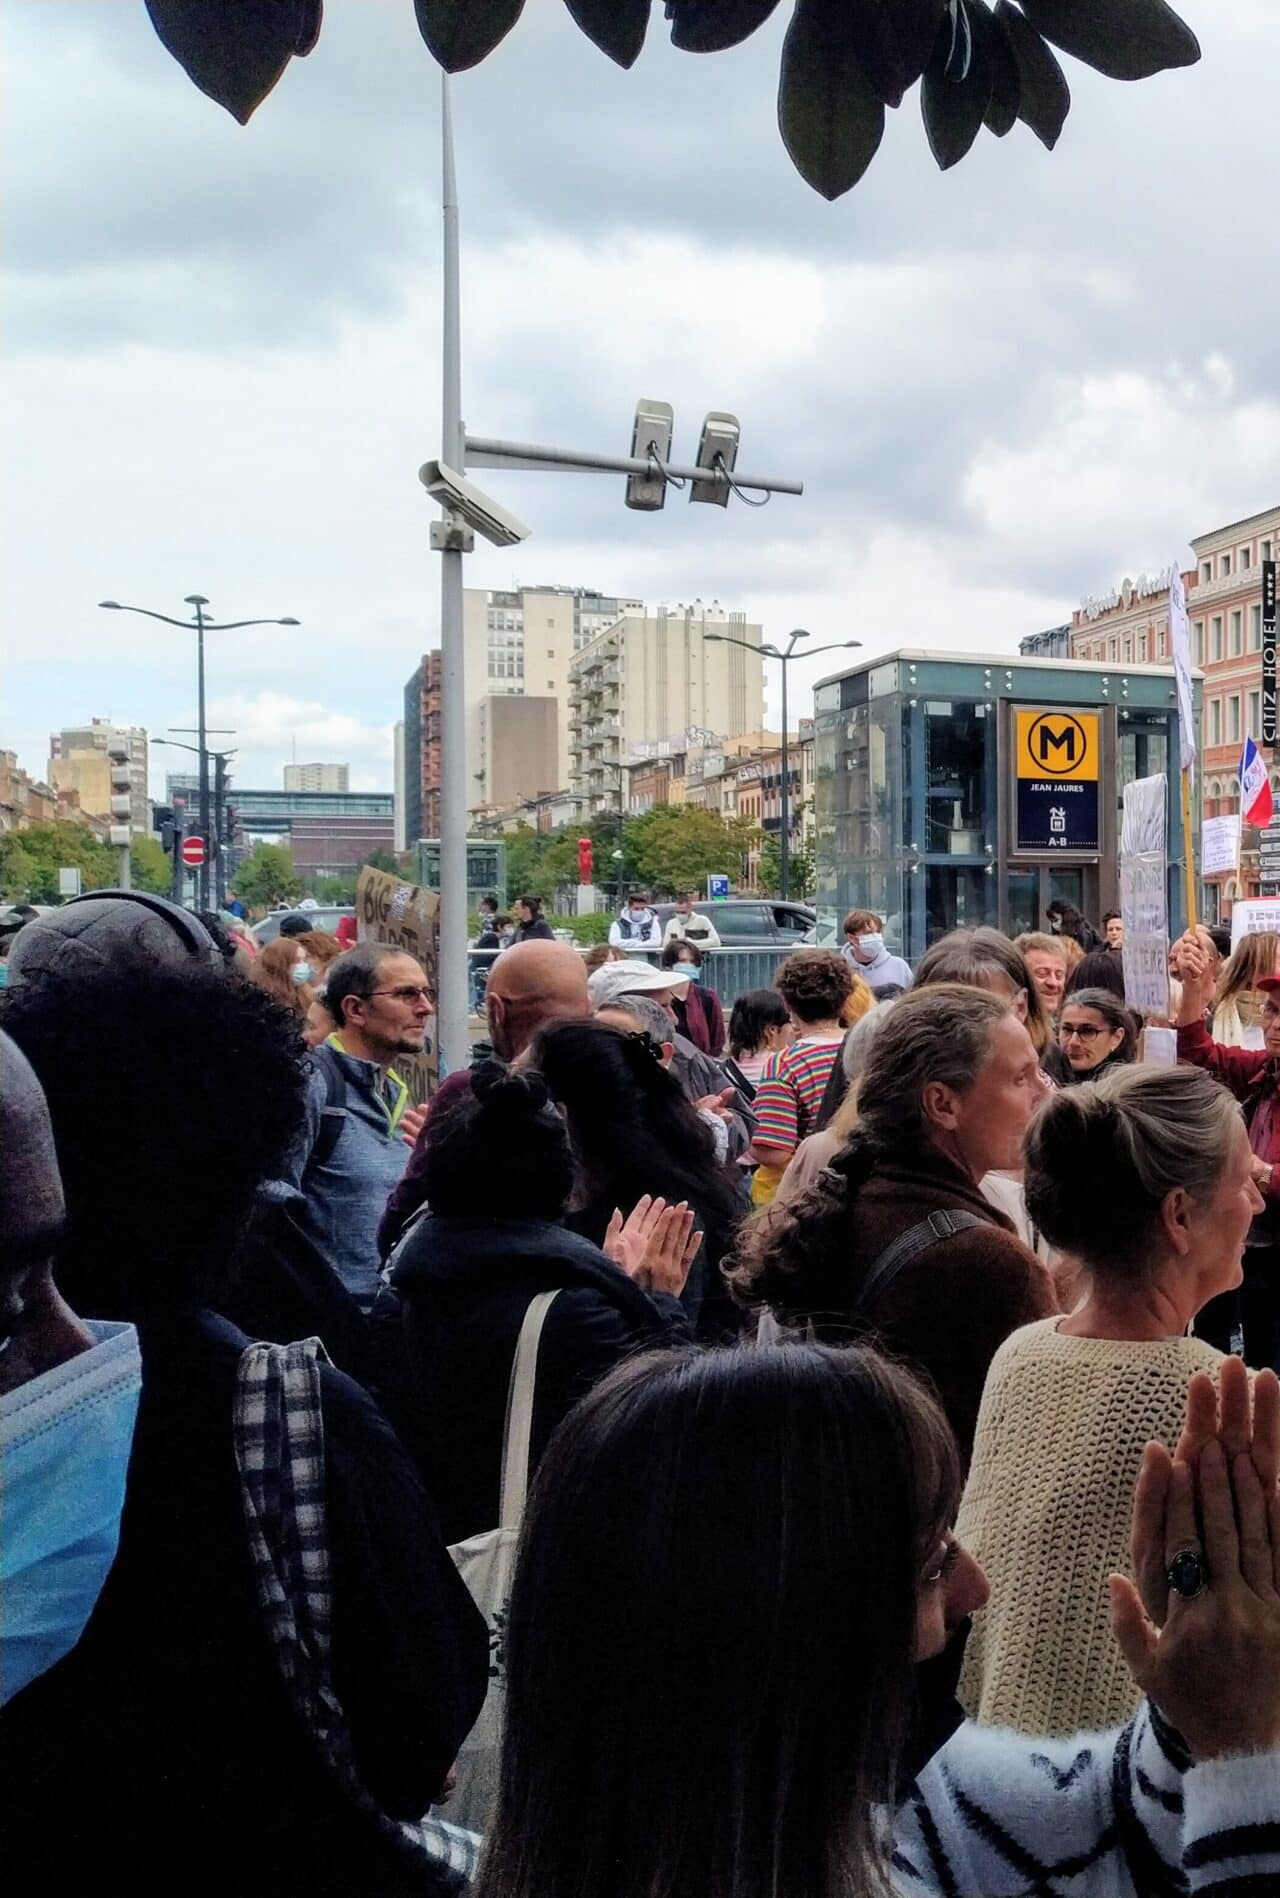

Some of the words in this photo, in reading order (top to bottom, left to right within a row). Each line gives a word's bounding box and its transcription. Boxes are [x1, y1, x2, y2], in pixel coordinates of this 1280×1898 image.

[1263, 615, 1276, 677] HOTEL
[1263, 690, 1276, 742] CITIZ
[1040, 725, 1075, 760] M
[1030, 783, 1052, 792] JEAN
[1053, 784, 1085, 793] JAURES
